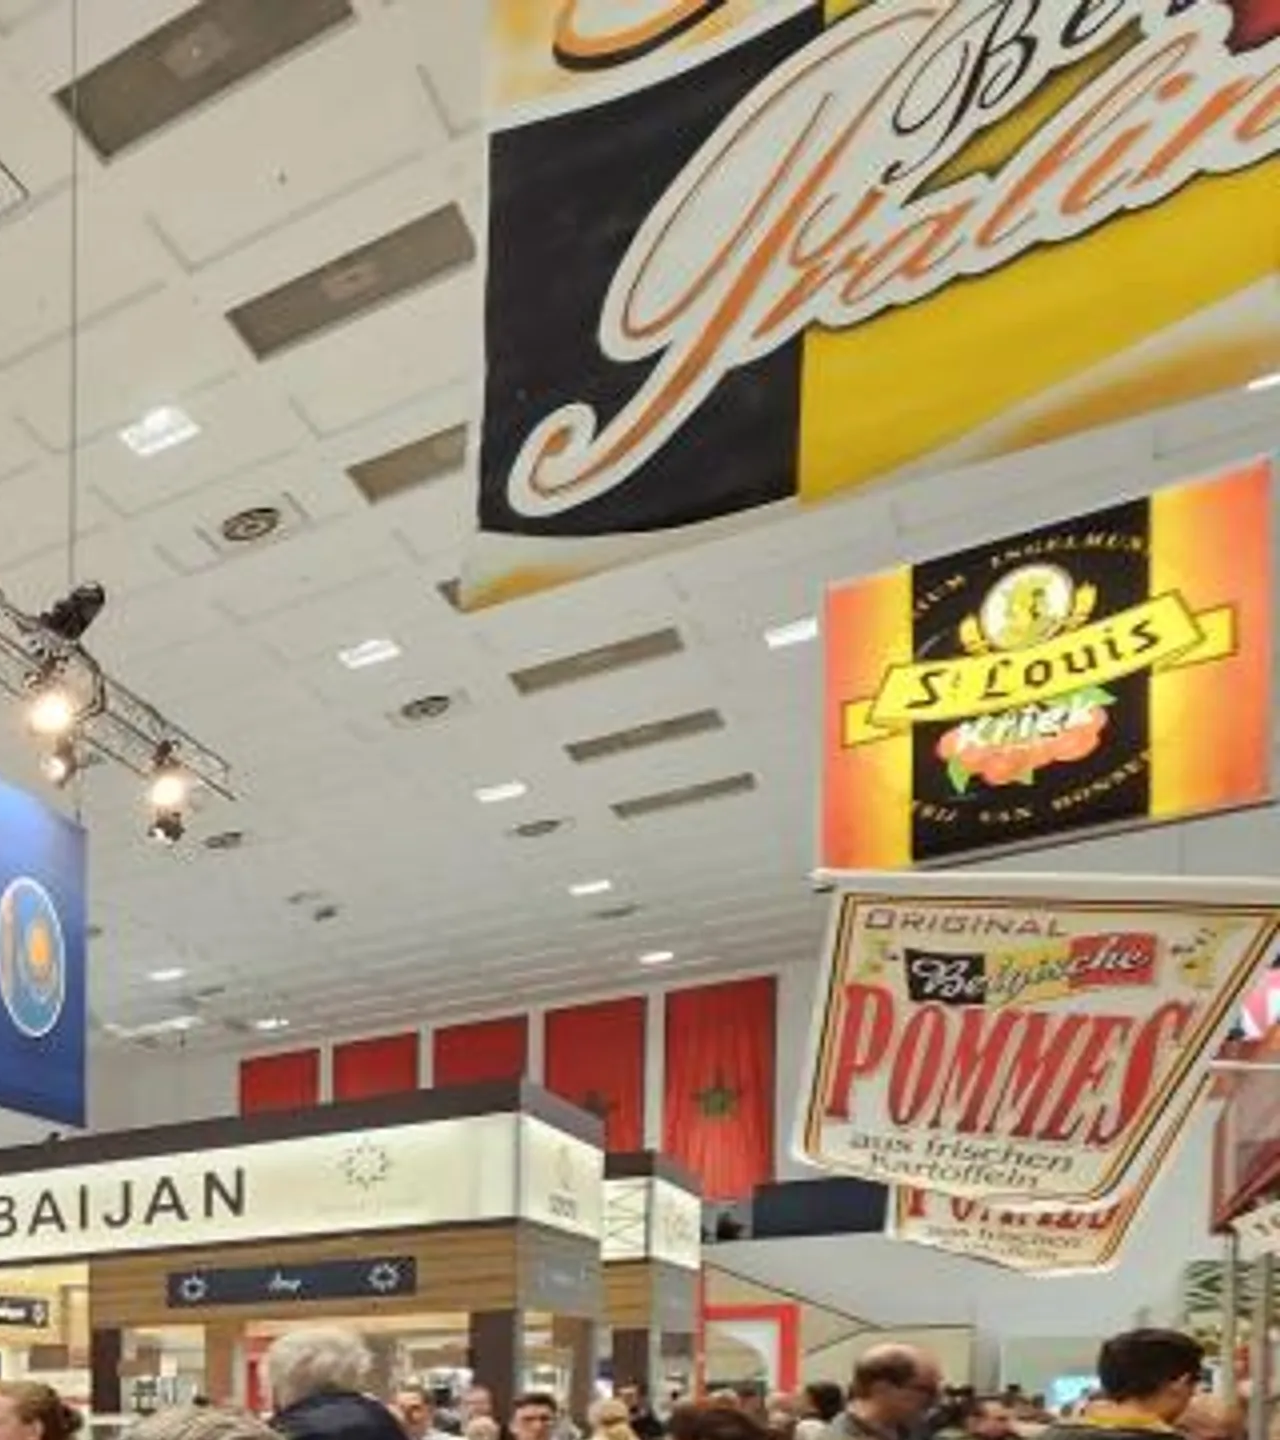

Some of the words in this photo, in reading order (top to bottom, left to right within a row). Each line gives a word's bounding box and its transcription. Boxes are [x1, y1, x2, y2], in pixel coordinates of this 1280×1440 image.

[980, 618, 1161, 699] Louis
[864, 907, 1068, 938] ORIGINAL
[911, 936, 1149, 998] Belgische
[825, 982, 1193, 1147] POMMES
[850, 1131, 914, 1154] aus
[923, 1138, 1075, 1173] frischen
[871, 1153, 1041, 1188] Kartoffeln
